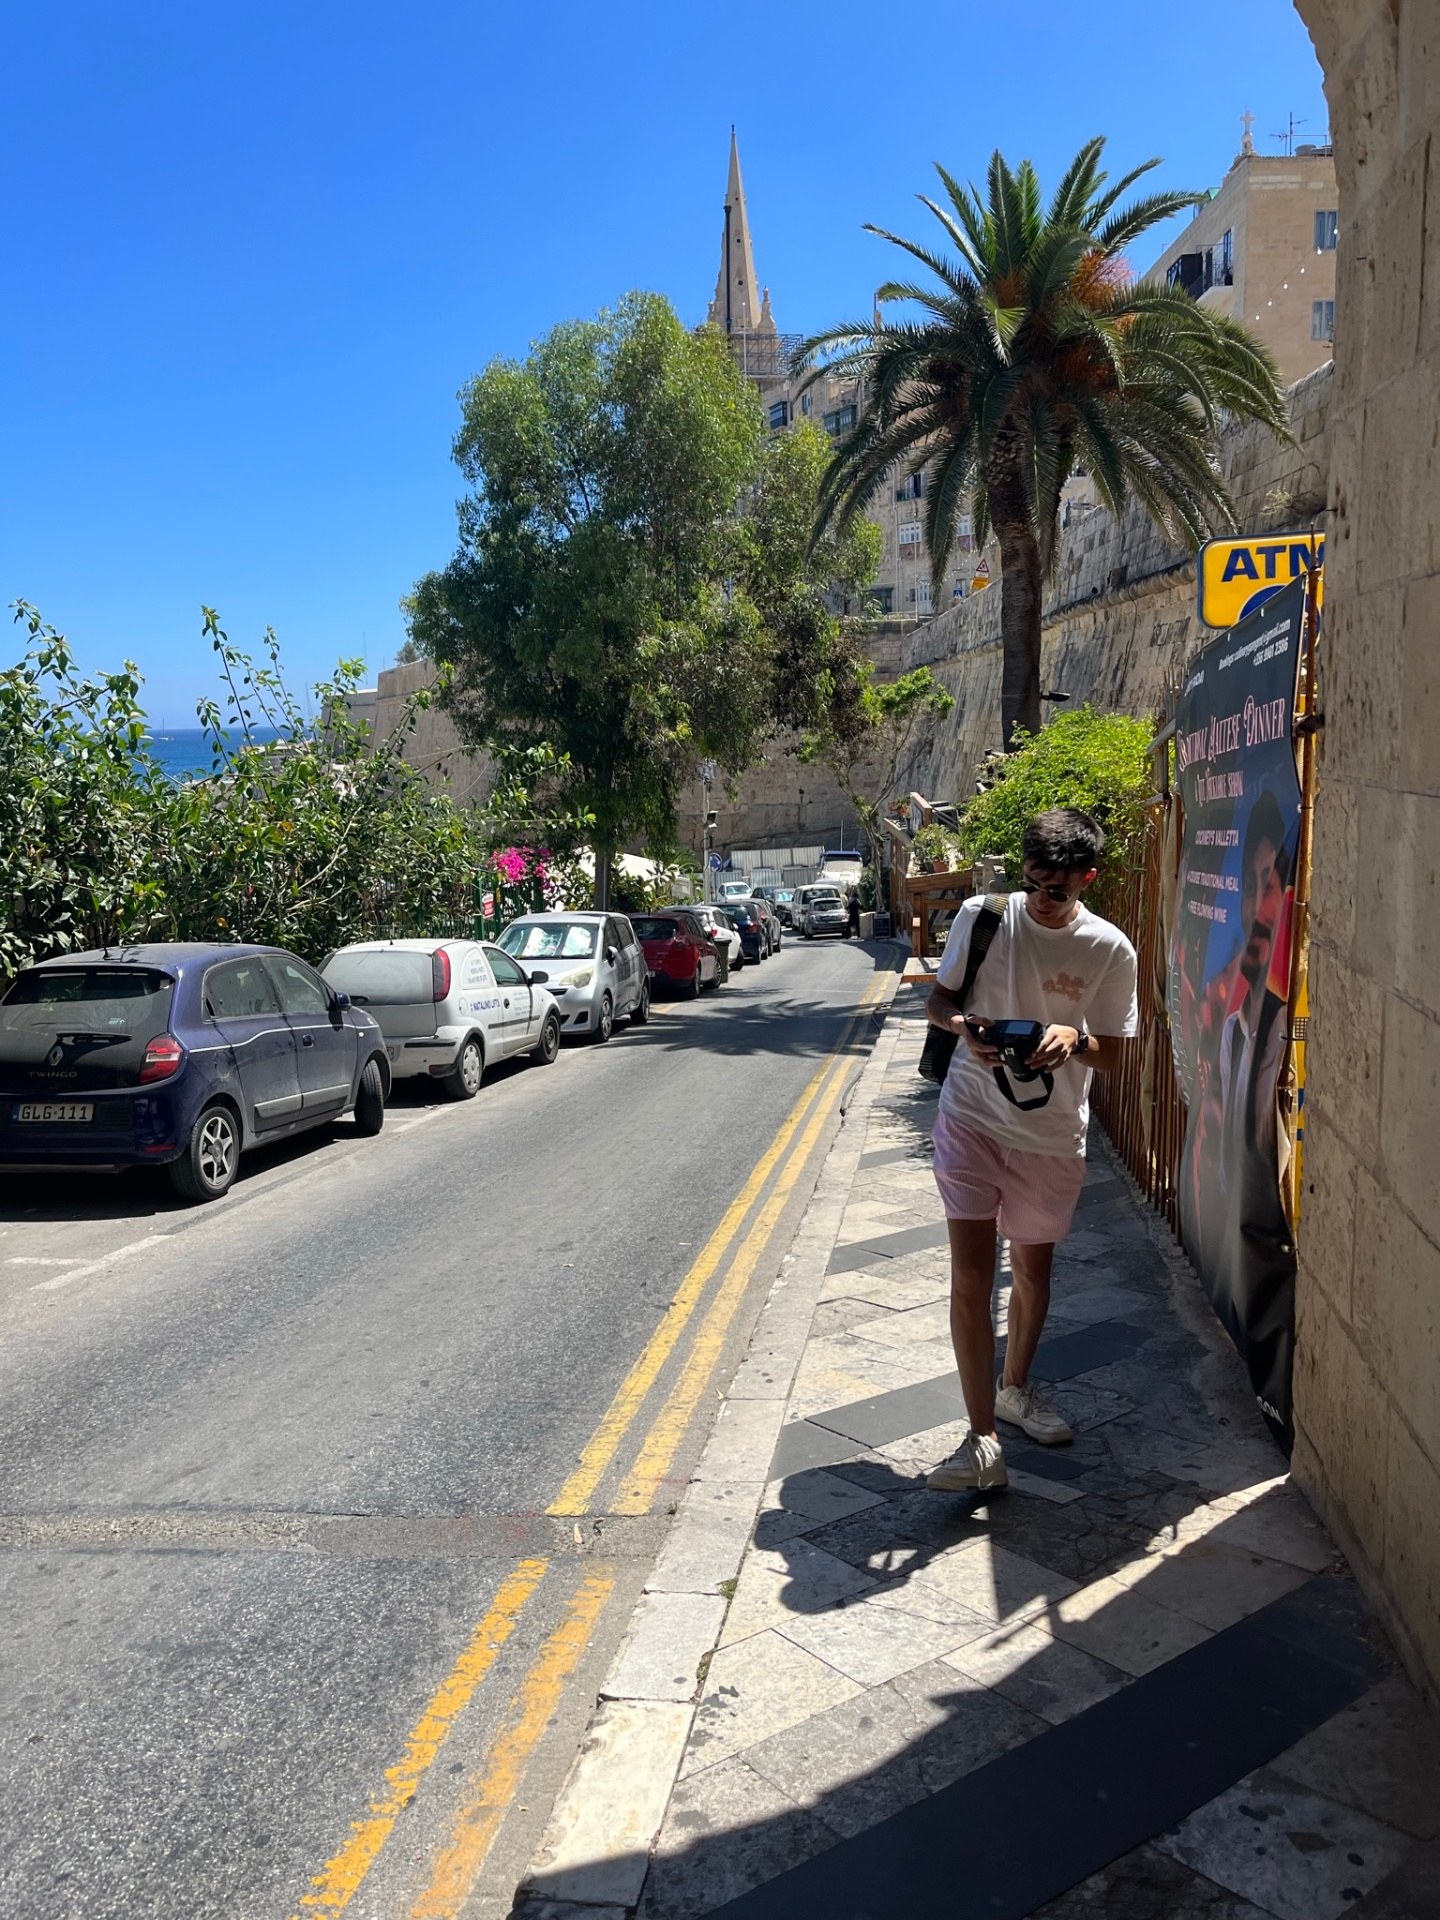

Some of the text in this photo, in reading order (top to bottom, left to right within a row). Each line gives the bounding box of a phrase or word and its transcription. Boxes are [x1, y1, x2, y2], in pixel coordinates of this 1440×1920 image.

[1221, 542, 1325, 582] ATM
[1243, 695, 1286, 747] DINNER
[1214, 829, 1239, 847] VALLETTA
[1225, 876, 1240, 892] MEAL
